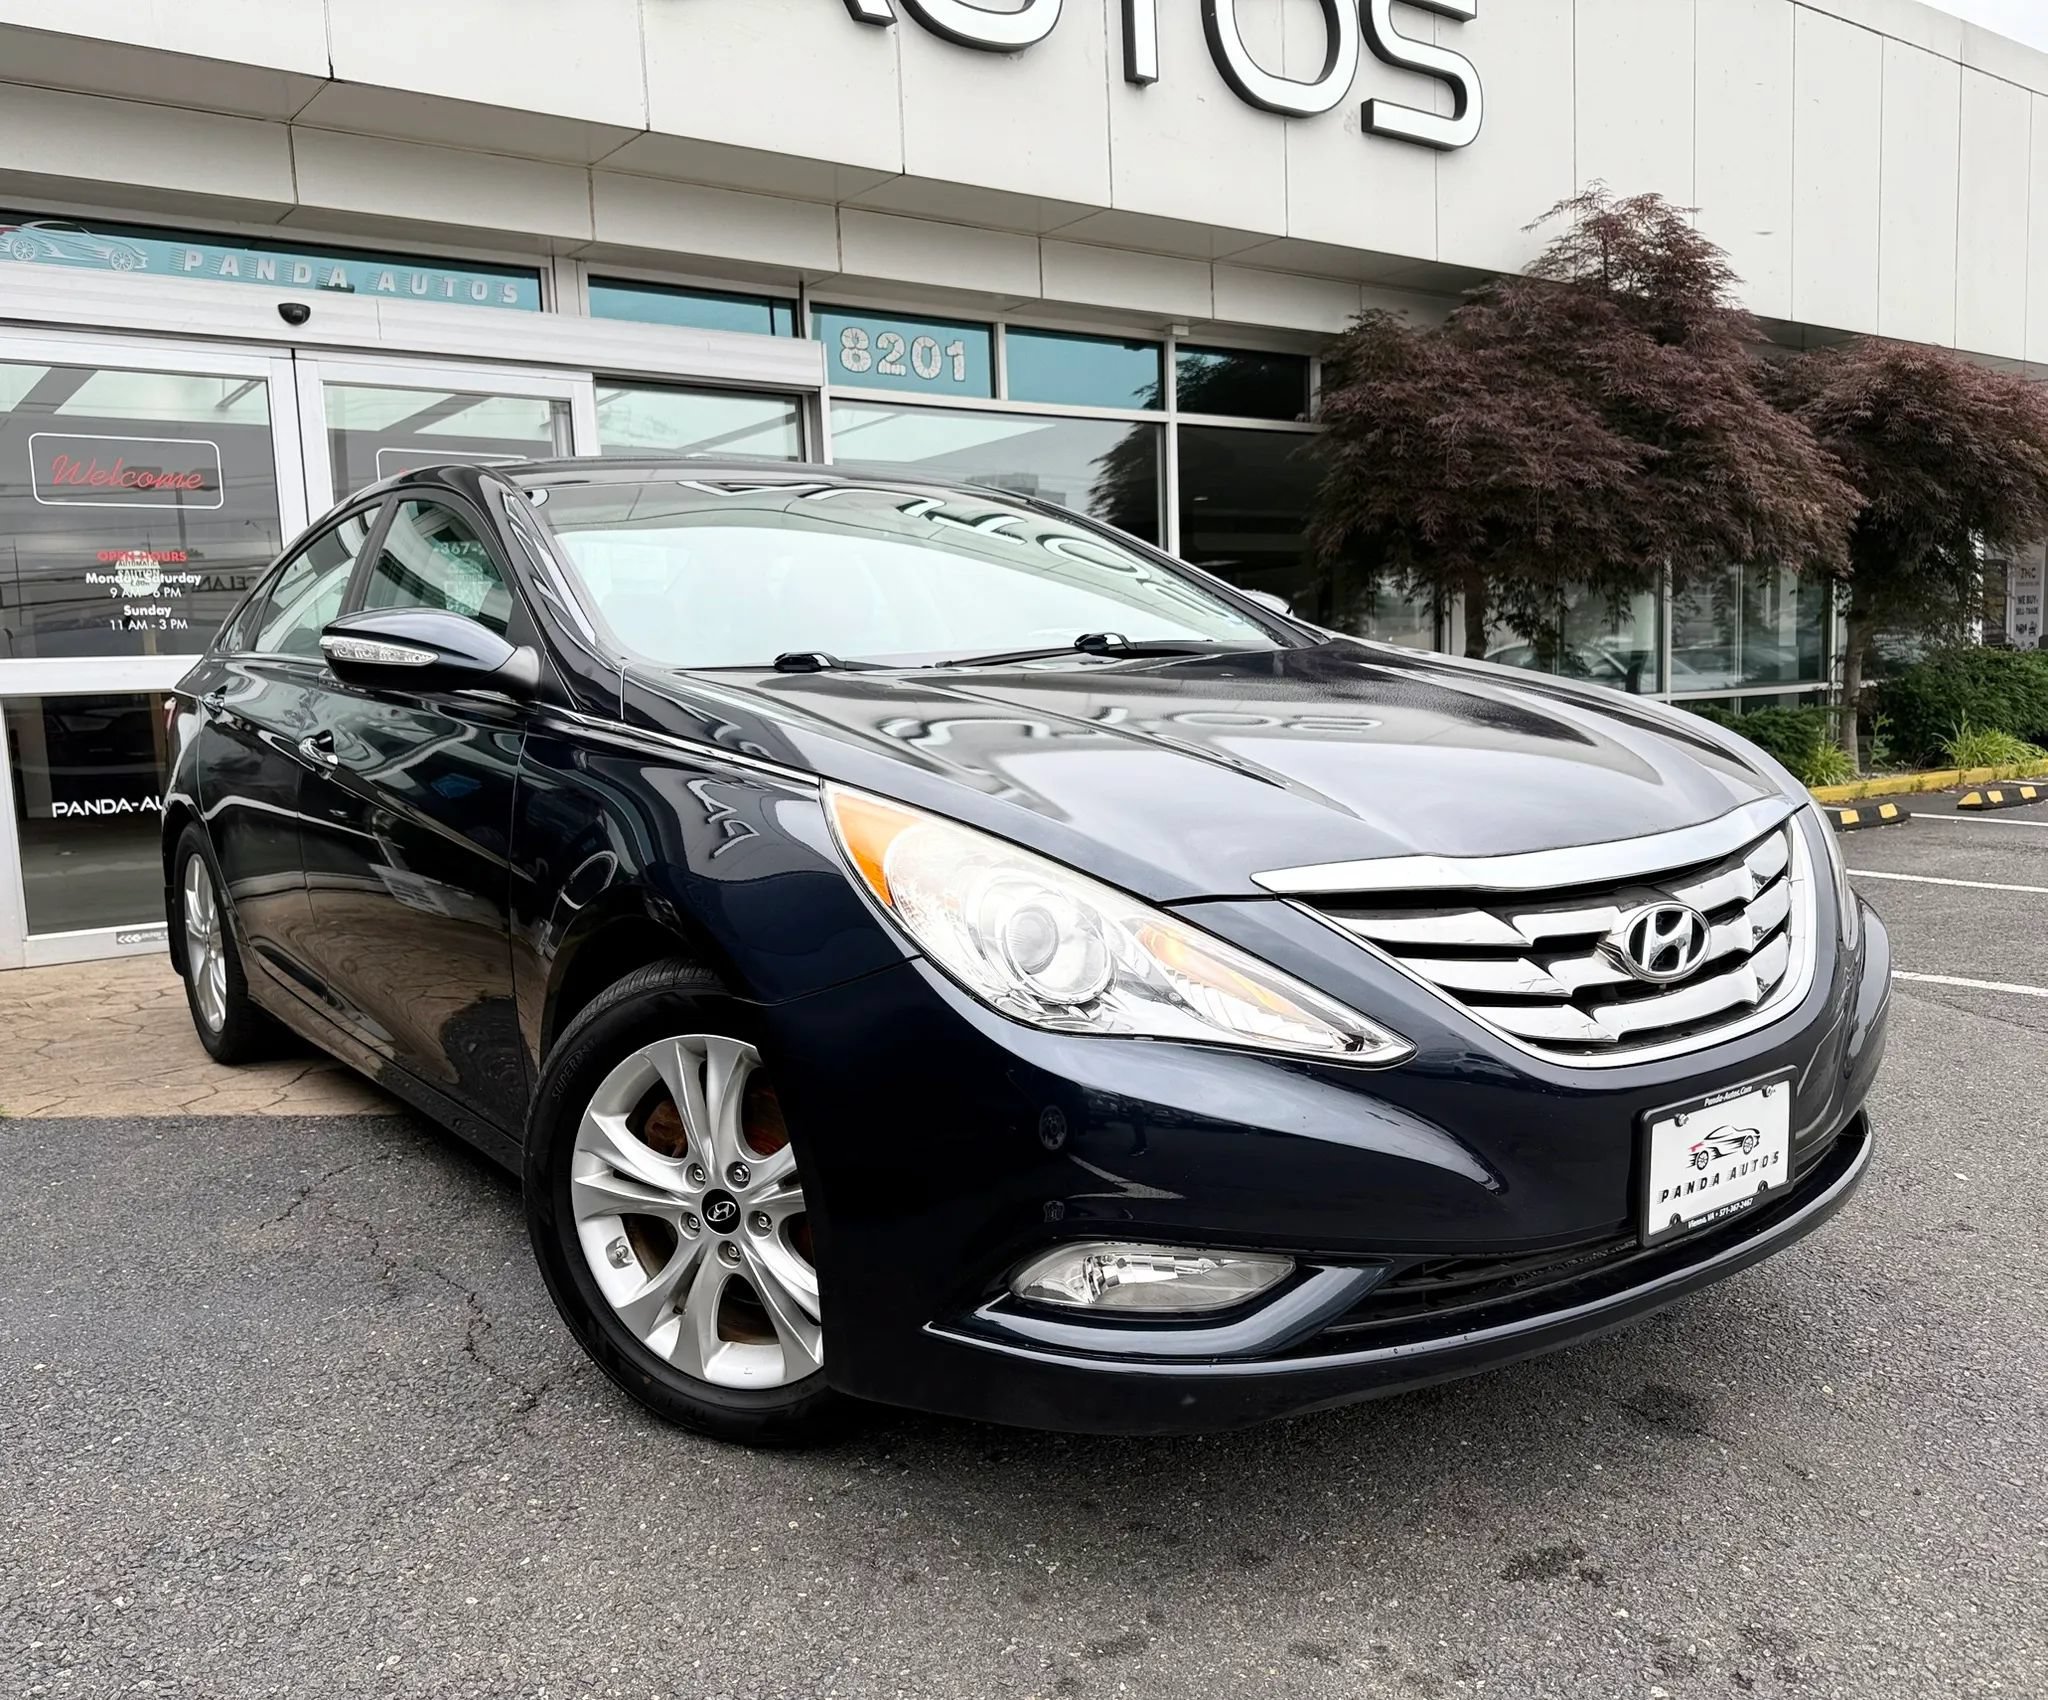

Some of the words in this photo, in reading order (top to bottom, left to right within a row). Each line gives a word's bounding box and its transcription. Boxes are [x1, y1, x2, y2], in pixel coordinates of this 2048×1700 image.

[183, 249, 348, 288] PANDA
[377, 271, 518, 303] AUTOS
[840, 327, 965, 382] 8201
[51, 455, 205, 489] Welcome
[110, 588, 117, 598] 9
[153, 587, 160, 598] 6
[164, 587, 181, 598] PM
[111, 620, 124, 630] 11
[128, 620, 148, 630] AM
[159, 619, 167, 630] 3
[171, 619, 188, 630] PM
[124, 604, 171, 617] Sunday
[1660, 1172, 1720, 1203] PANDA
[1729, 1150, 1779, 1180] AUTOS
